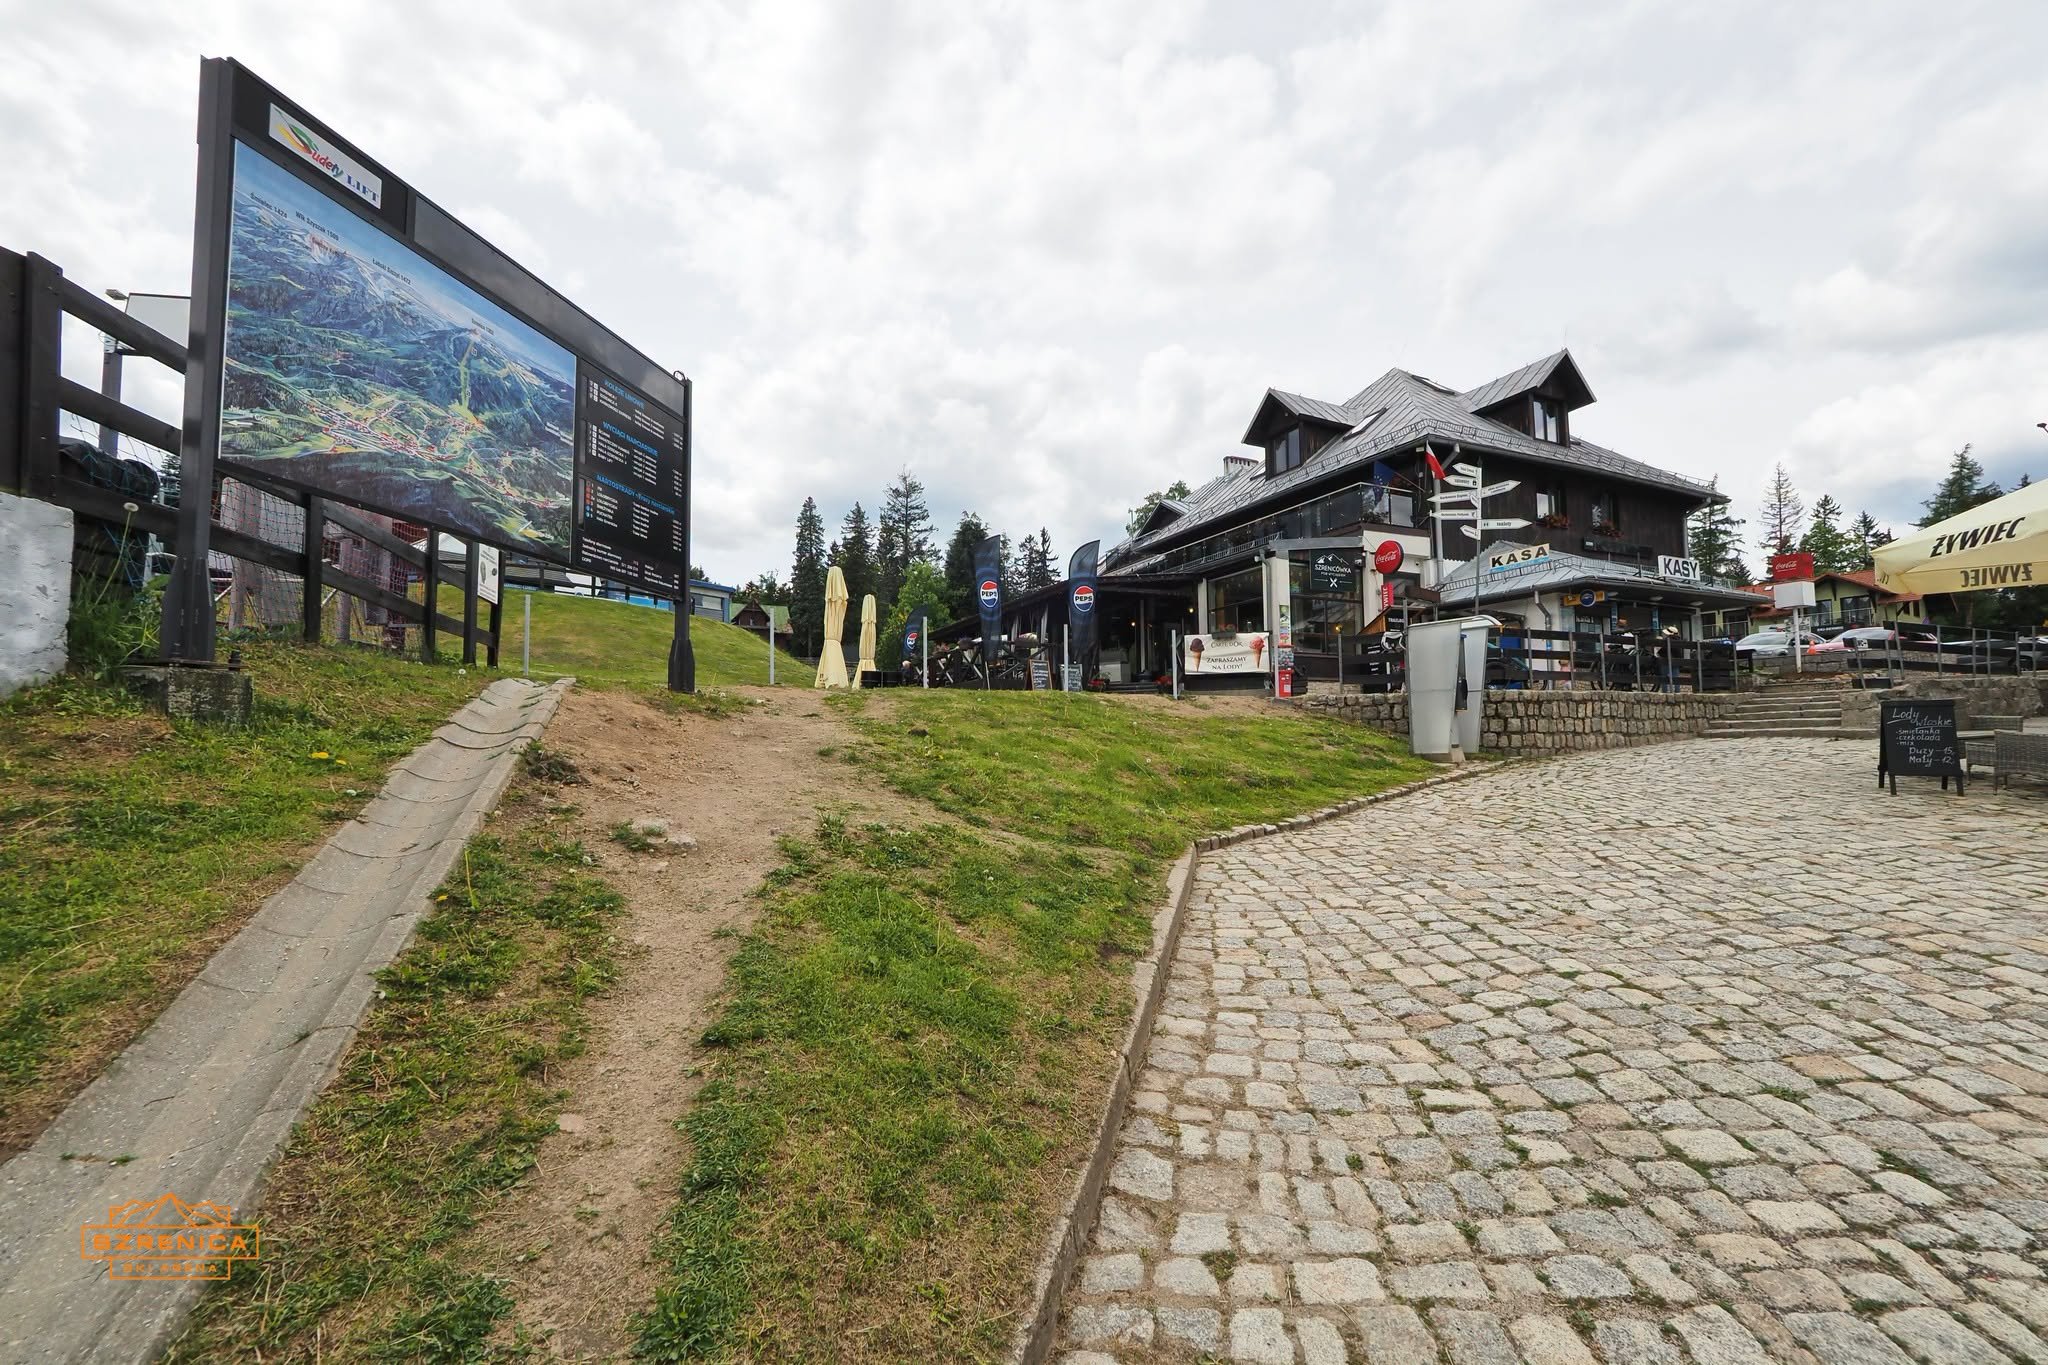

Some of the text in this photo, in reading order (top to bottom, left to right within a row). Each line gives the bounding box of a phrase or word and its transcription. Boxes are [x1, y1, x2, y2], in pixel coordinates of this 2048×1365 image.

[346, 174, 380, 203] LIFT
[1930, 516, 2026, 558] ŻYWIEC
[1376, 550, 1398, 565] Coca-Cola
[1491, 546, 1548, 568] KASA
[1775, 560, 1797, 570] Coca-Cola
[1314, 563, 1352, 574] SZRENICÓWKA
[1663, 557, 1698, 581] KASY
[1206, 656, 1247, 664] ZAPRASZAMY
[1892, 706, 1920, 724] Lody
